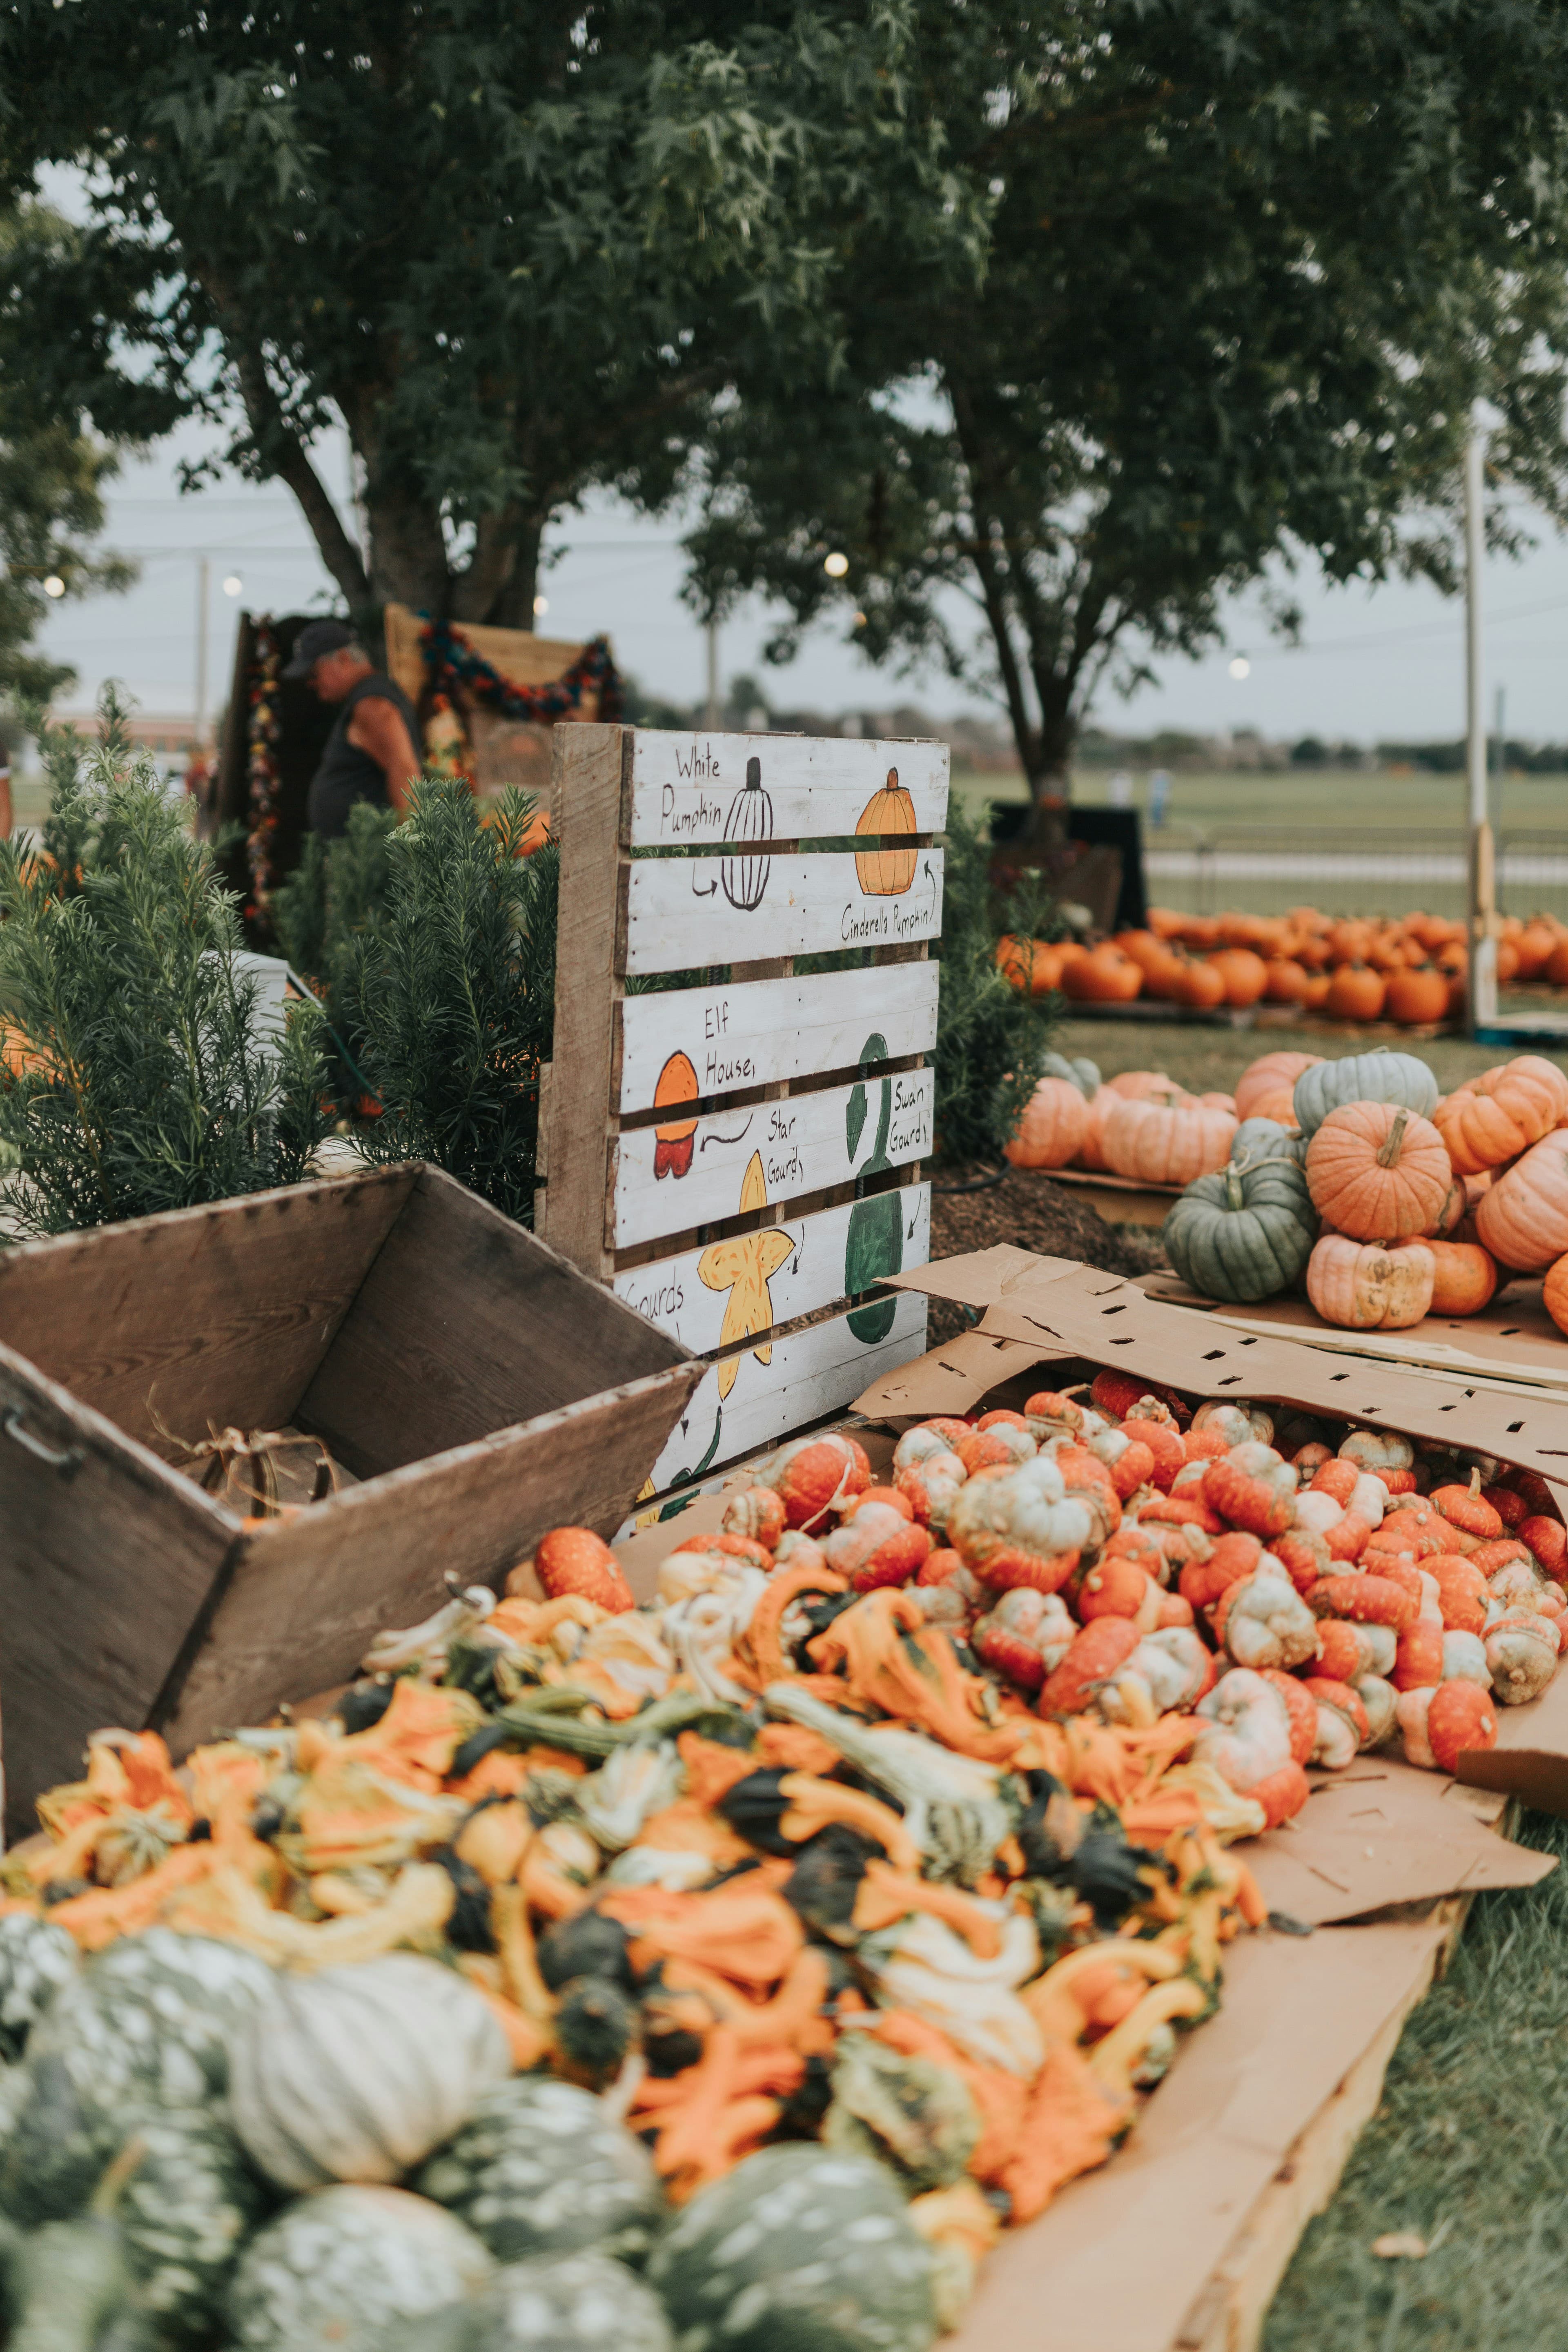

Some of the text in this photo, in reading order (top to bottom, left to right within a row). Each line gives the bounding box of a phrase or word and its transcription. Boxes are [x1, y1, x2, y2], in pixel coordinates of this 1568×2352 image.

[676, 742, 720, 778] White
[660, 783, 721, 836] Pumpkin
[842, 903, 928, 942] Cinderella Pumpkin
[706, 1001, 728, 1040] Elf
[895, 1081, 923, 1111] Swan
[768, 1109, 795, 1142] Star
